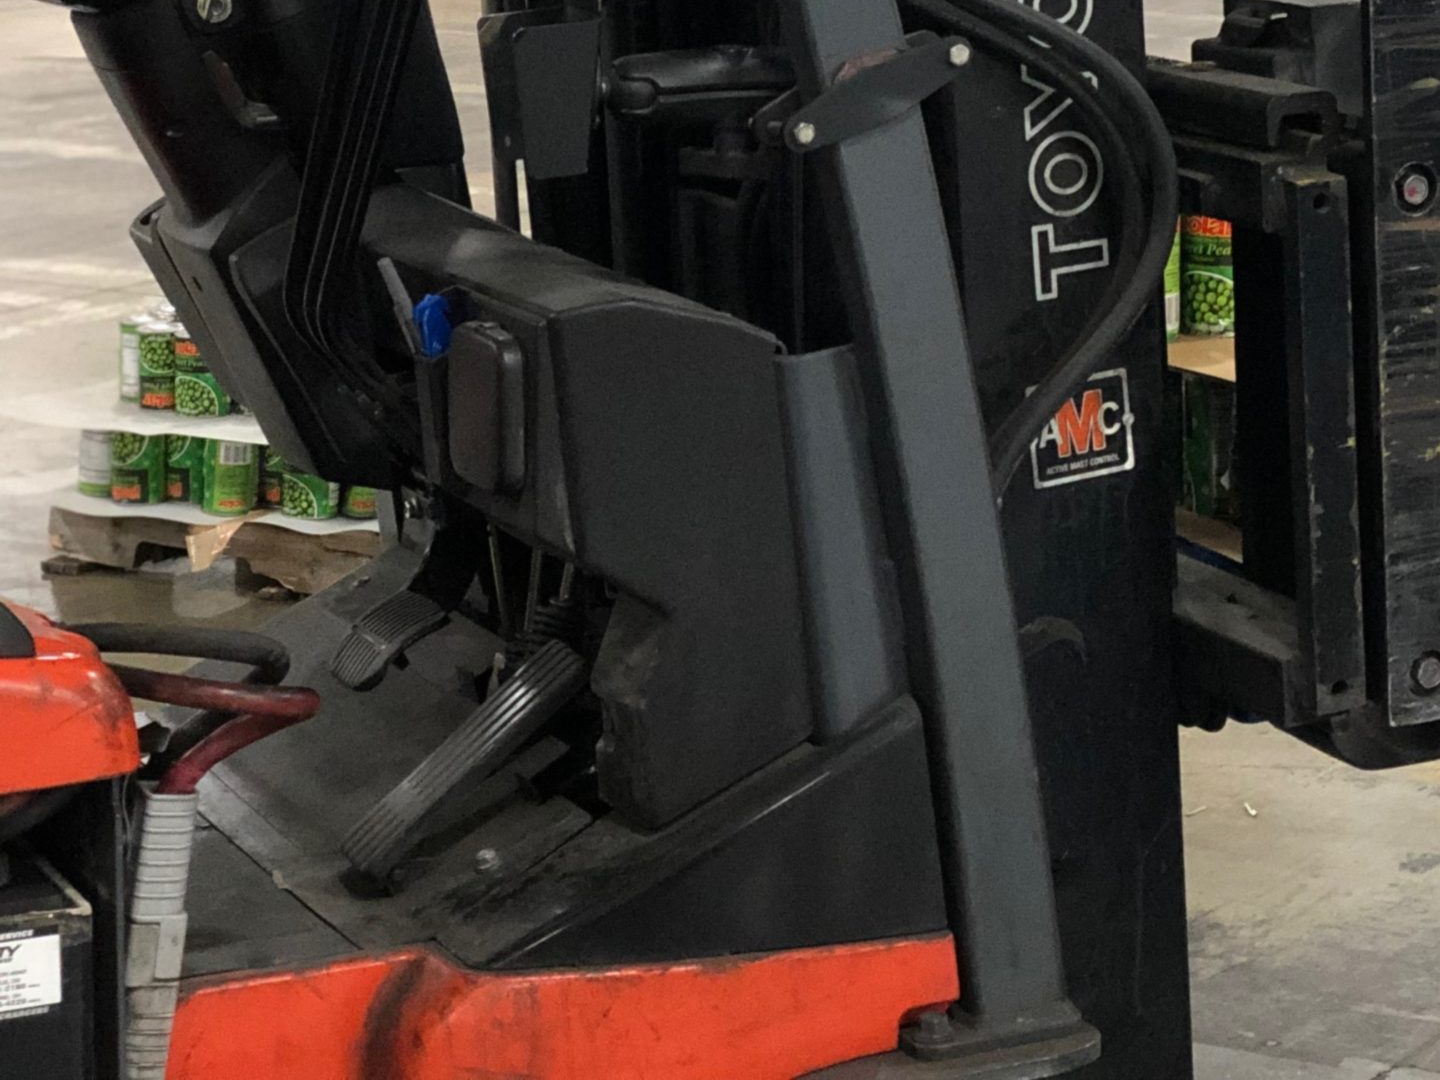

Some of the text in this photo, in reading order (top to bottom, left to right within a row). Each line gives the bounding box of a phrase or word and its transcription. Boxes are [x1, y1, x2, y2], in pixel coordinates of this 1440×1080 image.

[1039, 388, 1121, 458] AMC
[1046, 463, 1069, 475] ACTIVE
[1090, 453, 1119, 467] CONTROL
